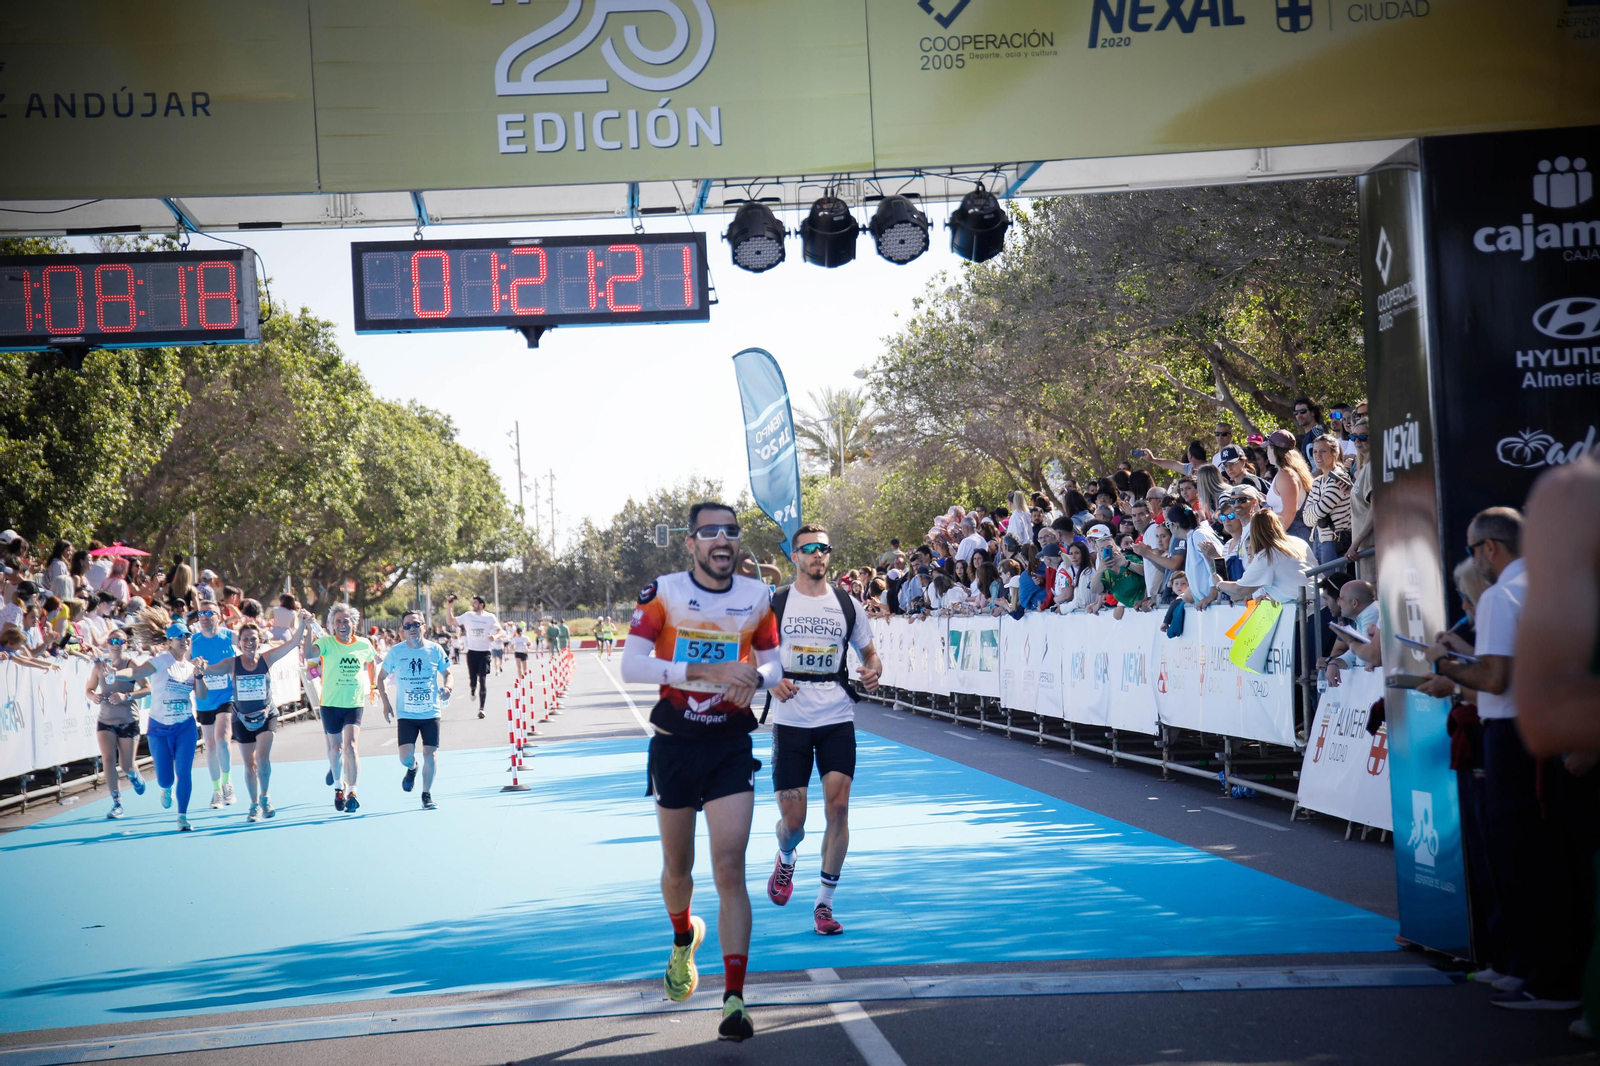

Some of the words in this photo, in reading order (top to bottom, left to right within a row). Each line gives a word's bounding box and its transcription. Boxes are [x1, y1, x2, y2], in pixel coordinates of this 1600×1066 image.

[1347, 0, 1430, 22] CIUDAD
[919, 29, 1054, 53] COOPERACIÓN
[1100, 36, 1131, 48] 2020
[920, 53, 965, 71] 2005
[1005, 50, 1022, 58] ocio
[1023, 50, 1029, 59] y
[1030, 48, 1058, 57] cultura
[25, 86, 211, 119] ANDÚJAR
[496, 97, 723, 154] EDICIÓN
[1383, 418, 1423, 482] NEXAL
[687, 641, 725, 660] 525
[797, 653, 833, 667] 1816
[239, 679, 264, 688] 5523
[407, 692, 431, 701] 5569
